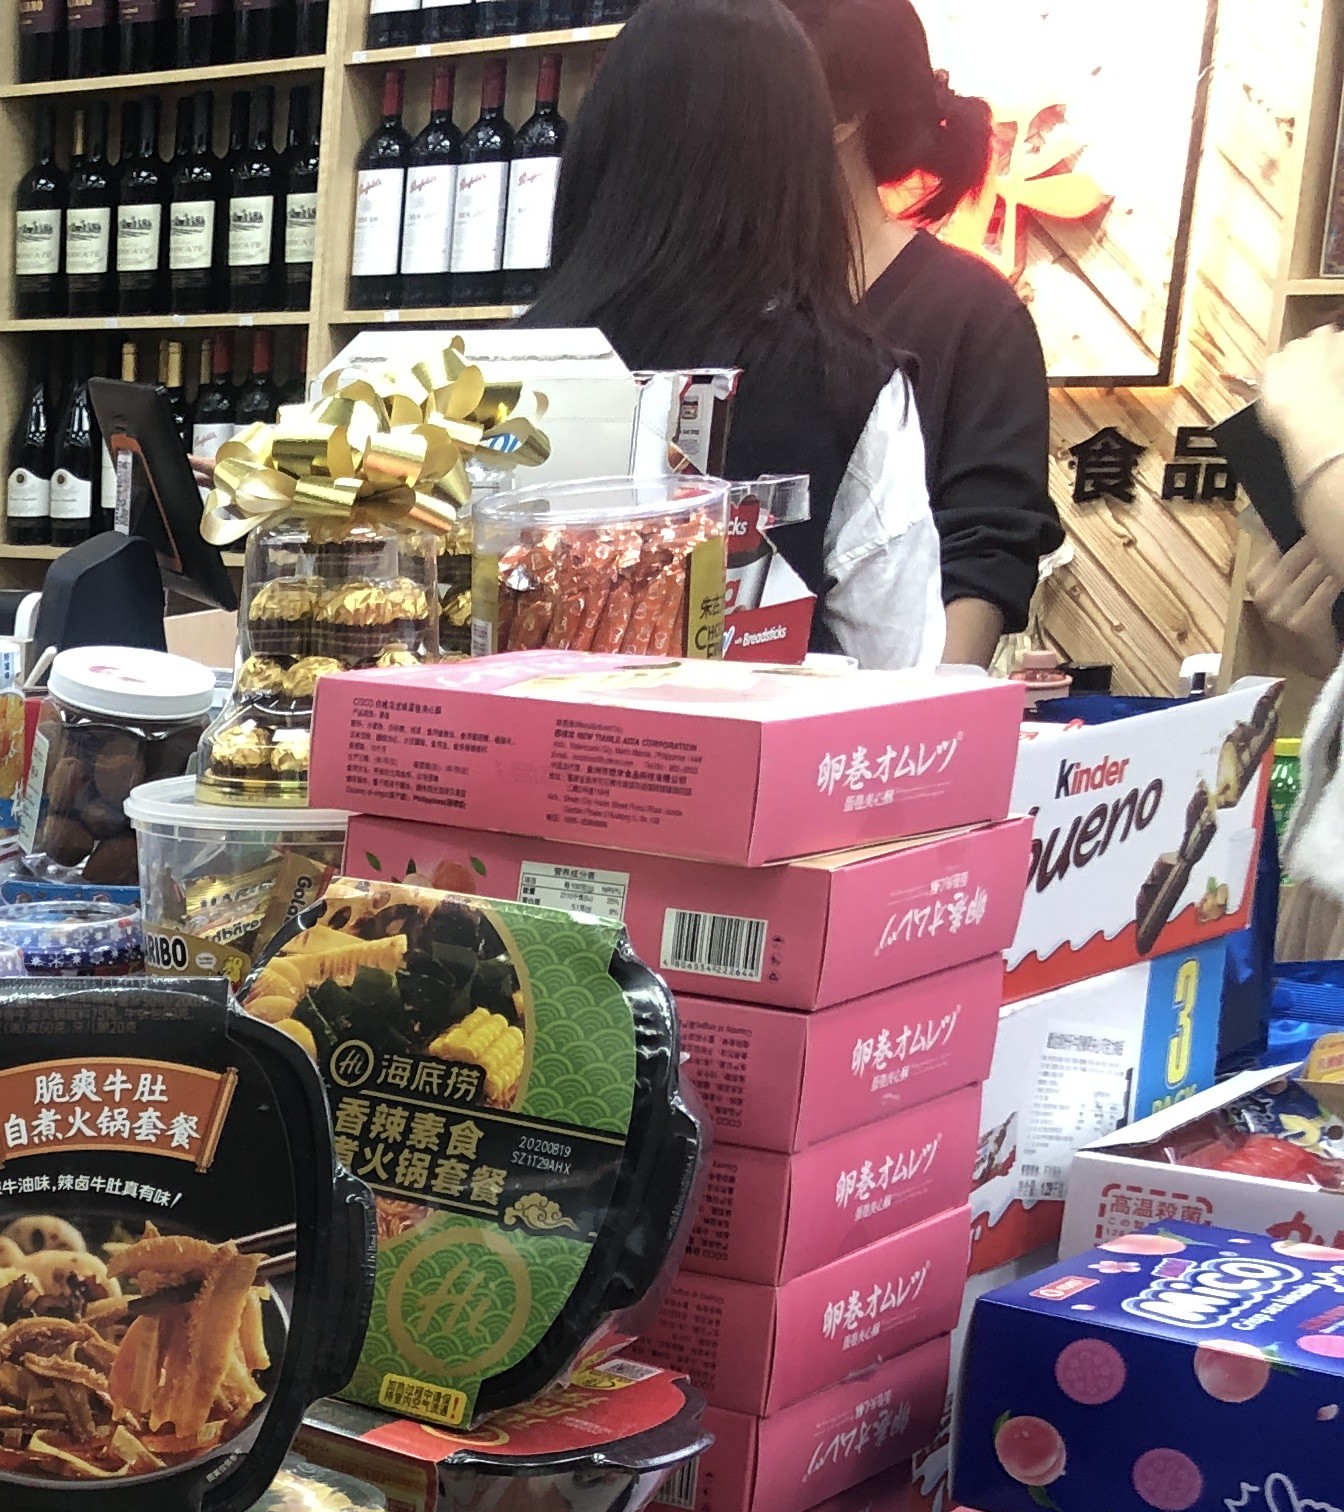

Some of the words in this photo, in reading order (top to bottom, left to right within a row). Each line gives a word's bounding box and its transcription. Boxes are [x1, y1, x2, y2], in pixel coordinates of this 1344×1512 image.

[1068, 426, 1242, 505] 食品
[1055, 756, 1130, 800] Kinder
[1168, 956, 1201, 1085] 3
[34, 1073, 170, 1106] 脆爽牛肚
[376, 1054, 482, 1103] 海底捞
[4, 1109, 202, 1150] 自煮火锅套餐
[334, 1098, 486, 1161] 香辣素食
[336, 1136, 510, 1208] 煮火锅套餐
[1110, 1194, 1204, 1225] 高温殺菌
